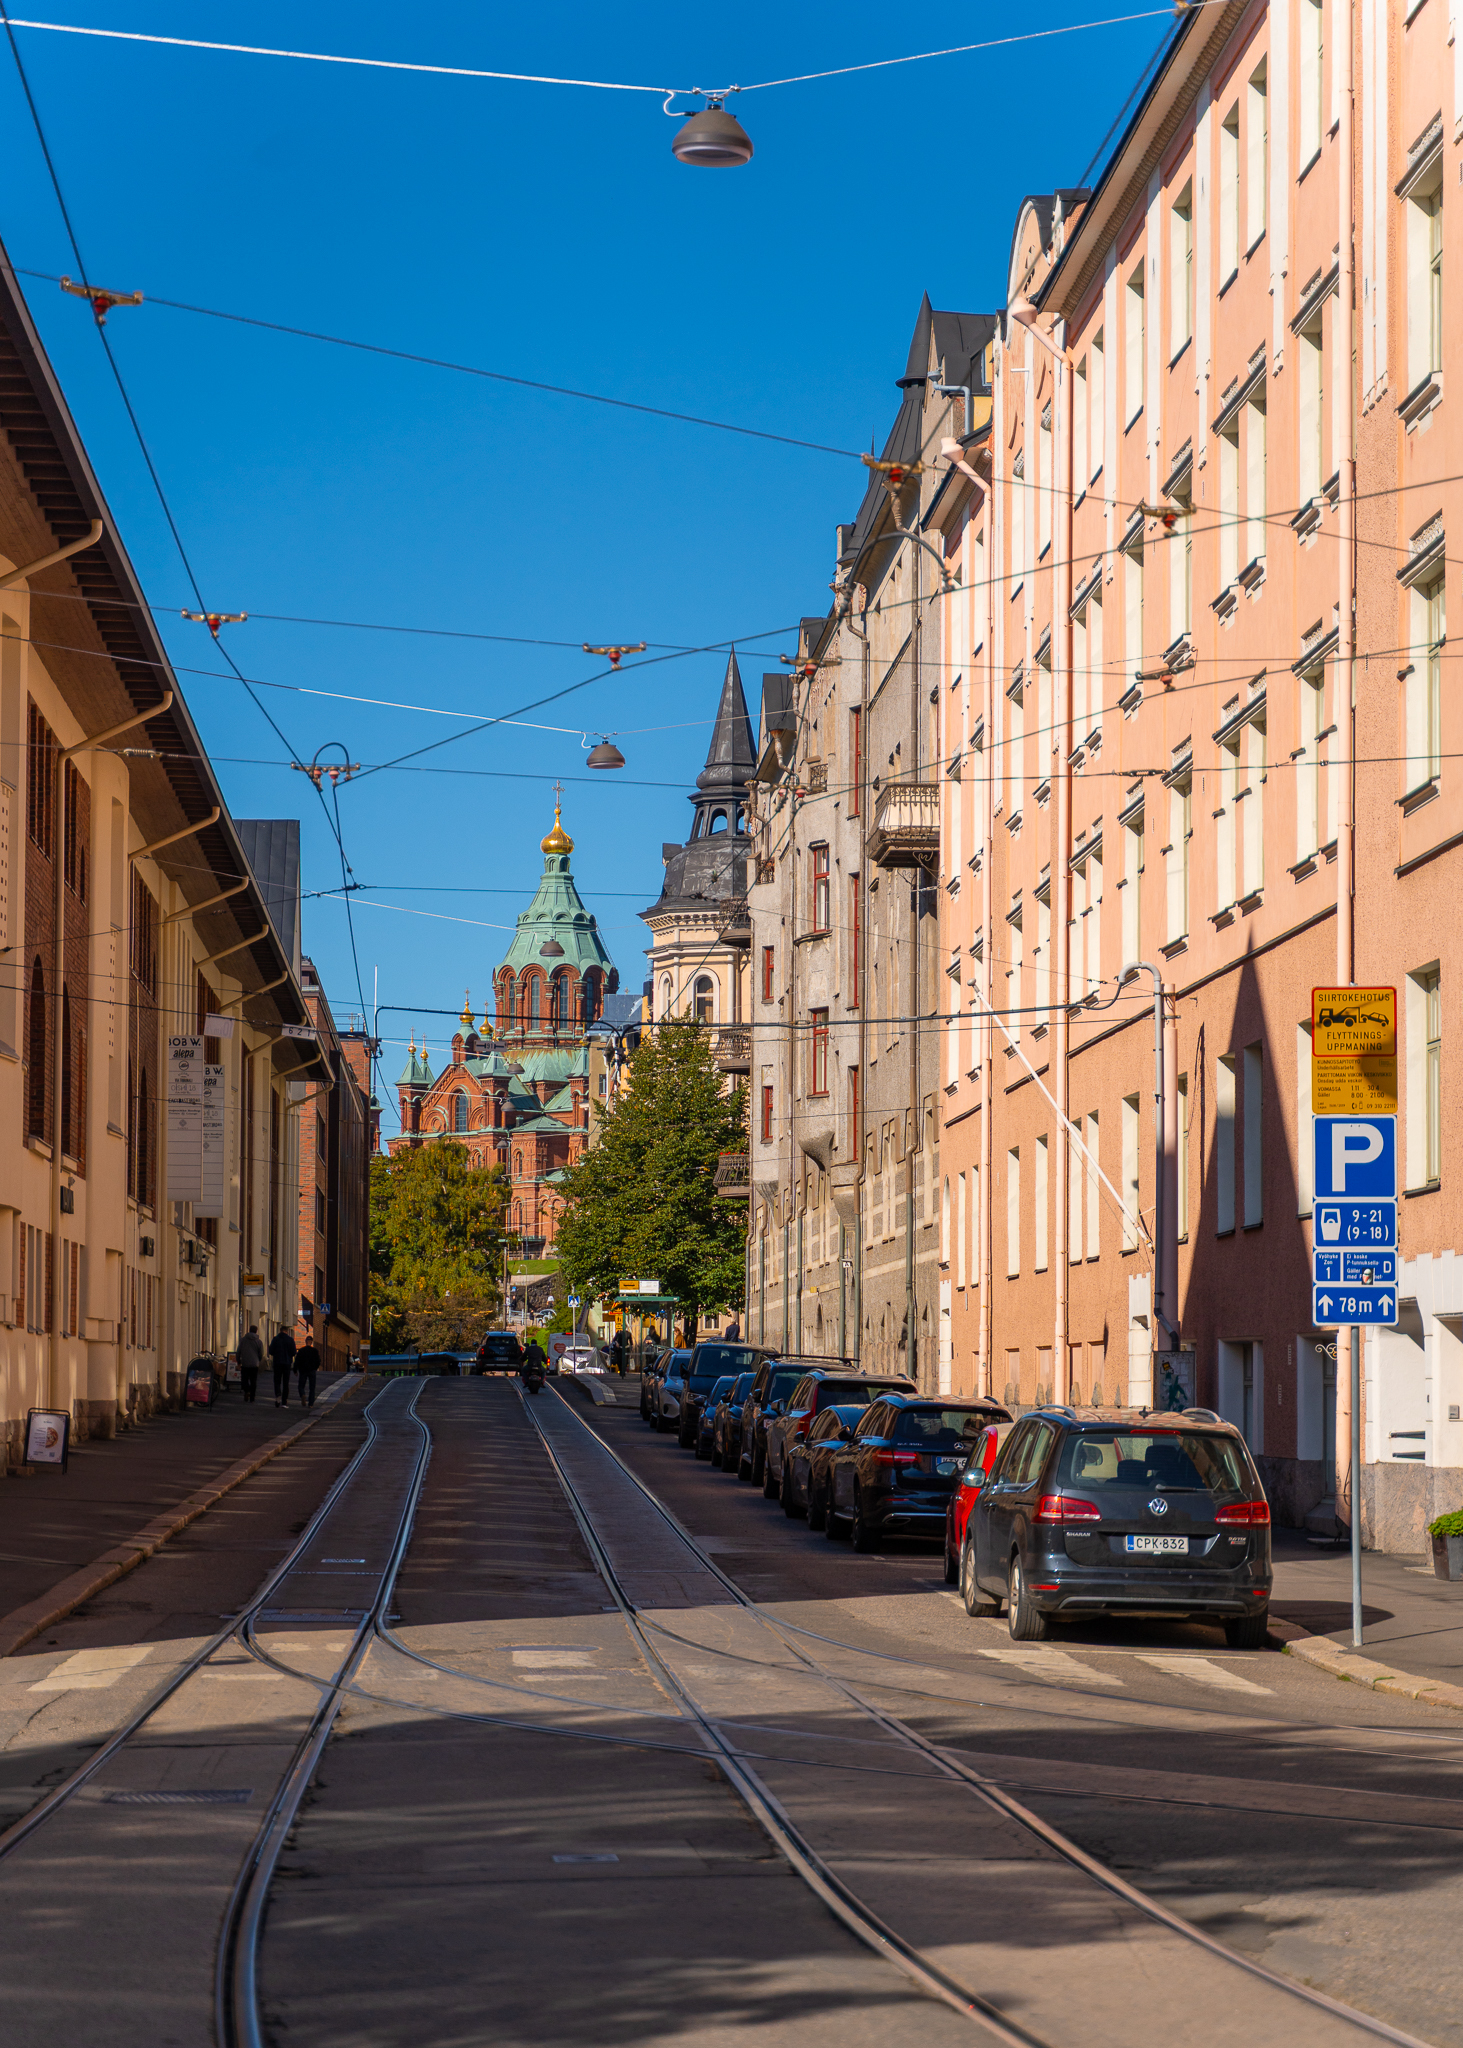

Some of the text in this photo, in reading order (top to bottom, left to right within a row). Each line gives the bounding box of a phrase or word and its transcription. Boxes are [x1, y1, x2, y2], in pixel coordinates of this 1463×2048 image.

[1318, 994, 1390, 1002] SIIRTOKEHOTUS
[190, 1038, 201, 1046] W.
[173, 1049, 194, 1058] alepa
[1332, 1123, 1384, 1191] P
[1383, 1261, 1392, 1273] D
[1326, 1267, 1330, 1279] 1
